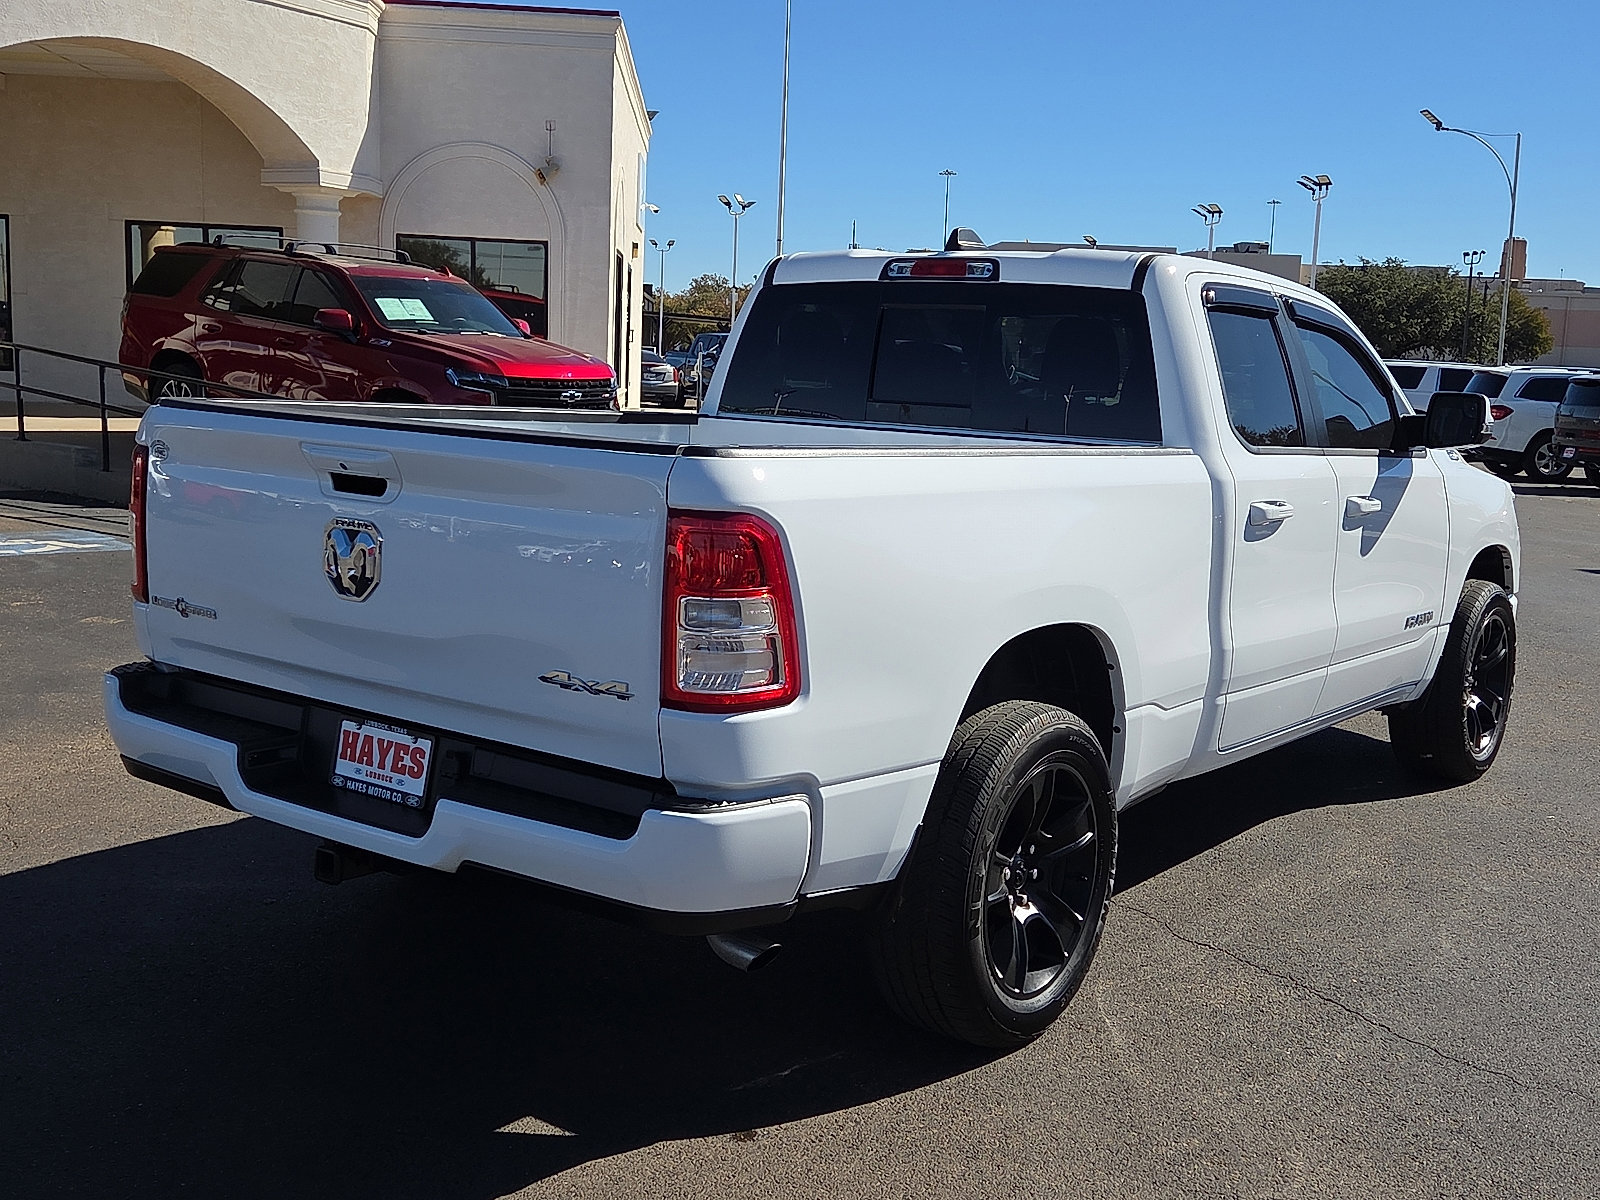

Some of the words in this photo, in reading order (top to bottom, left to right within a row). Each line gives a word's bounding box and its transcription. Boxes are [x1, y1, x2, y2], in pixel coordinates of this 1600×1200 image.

[335, 519, 373, 530] RAM
[1404, 611, 1433, 630] RAM
[339, 728, 426, 780] HAYES
[365, 769, 394, 784] LUBBOCK
[346, 780, 367, 793] HAYES
[368, 785, 391, 800] MOTOR
[392, 792, 404, 804] CO.
